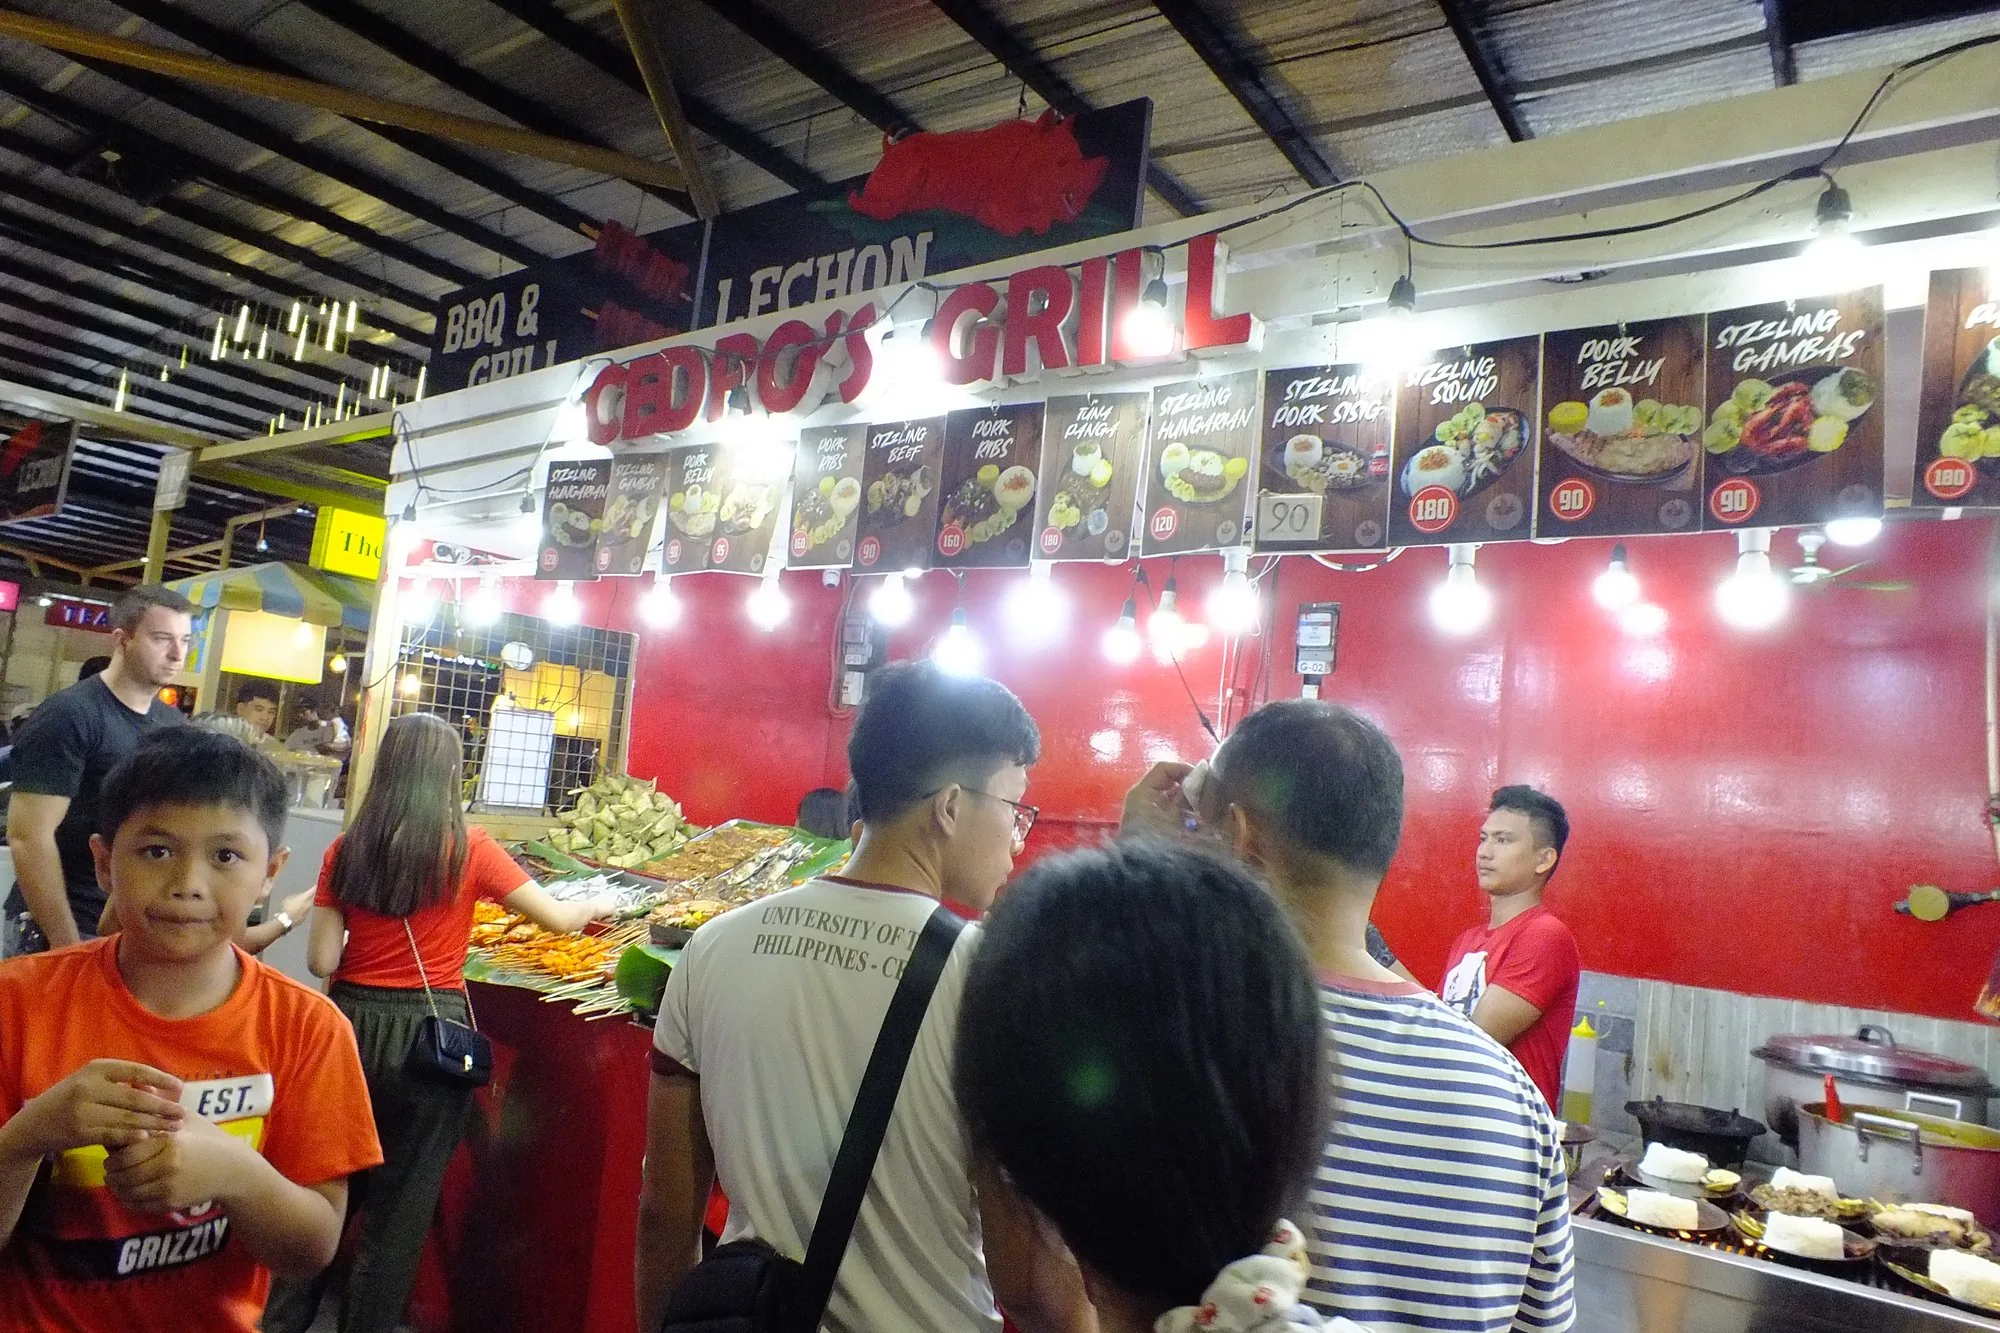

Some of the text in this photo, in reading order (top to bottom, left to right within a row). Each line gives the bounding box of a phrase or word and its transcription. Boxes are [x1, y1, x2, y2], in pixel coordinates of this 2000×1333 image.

[716, 230, 934, 328] LECHON
[442, 283, 540, 354] BBQ &
[932, 232, 1254, 385] GRILL
[1715, 309, 1842, 350] SIZZLING
[1577, 336, 1644, 365] PORK
[1732, 330, 1865, 373] GAMBAS
[1404, 356, 1496, 388] SIZZLING
[1581, 357, 1666, 390] BELLY
[1430, 375, 1499, 405] SQUID
[1158, 387, 1233, 417] SIZZLING
[1076, 406, 1113, 422] TUNA
[1157, 406, 1255, 440] HUNGARIAN
[1271, 401, 1386, 429] PORK SISIG
[871, 427, 928, 449] SIZZLING
[972, 419, 1013, 439] PORK
[1064, 421, 1120, 440] PANGA
[817, 436, 847, 453] PORK
[888, 445, 922, 463] BEEF
[974, 438, 1014, 460] RIBS
[683, 453, 709, 470] PORK
[818, 453, 847, 471] RIBS
[550, 467, 597, 483] SIZZLING
[619, 476, 659, 492] GAMBAS
[683, 467, 716, 486] BELLY
[1934, 469, 1965, 488] 180
[548, 483, 610, 500] HUNGARIAN
[1559, 489, 1583, 511] 90
[1721, 489, 1747, 512] 90
[1272, 502, 1309, 533] 90
[1415, 499, 1449, 522] 180
[1155, 516, 1173, 533] 120
[717, 544, 726, 556] 95
[863, 543, 876, 559] 90
[942, 533, 960, 548] 160
[1043, 533, 1059, 547] 180
[63, 605, 110, 627] TEA
[1300, 662, 1324, 672] G-02
[761, 906, 876, 941] UNIVERSITY
[877, 923, 905, 947] OF
[752, 934, 869, 973] PHILIPPINES
[198, 1085, 254, 1116] EST.
[117, 1216, 229, 1275] GRIZZLY
